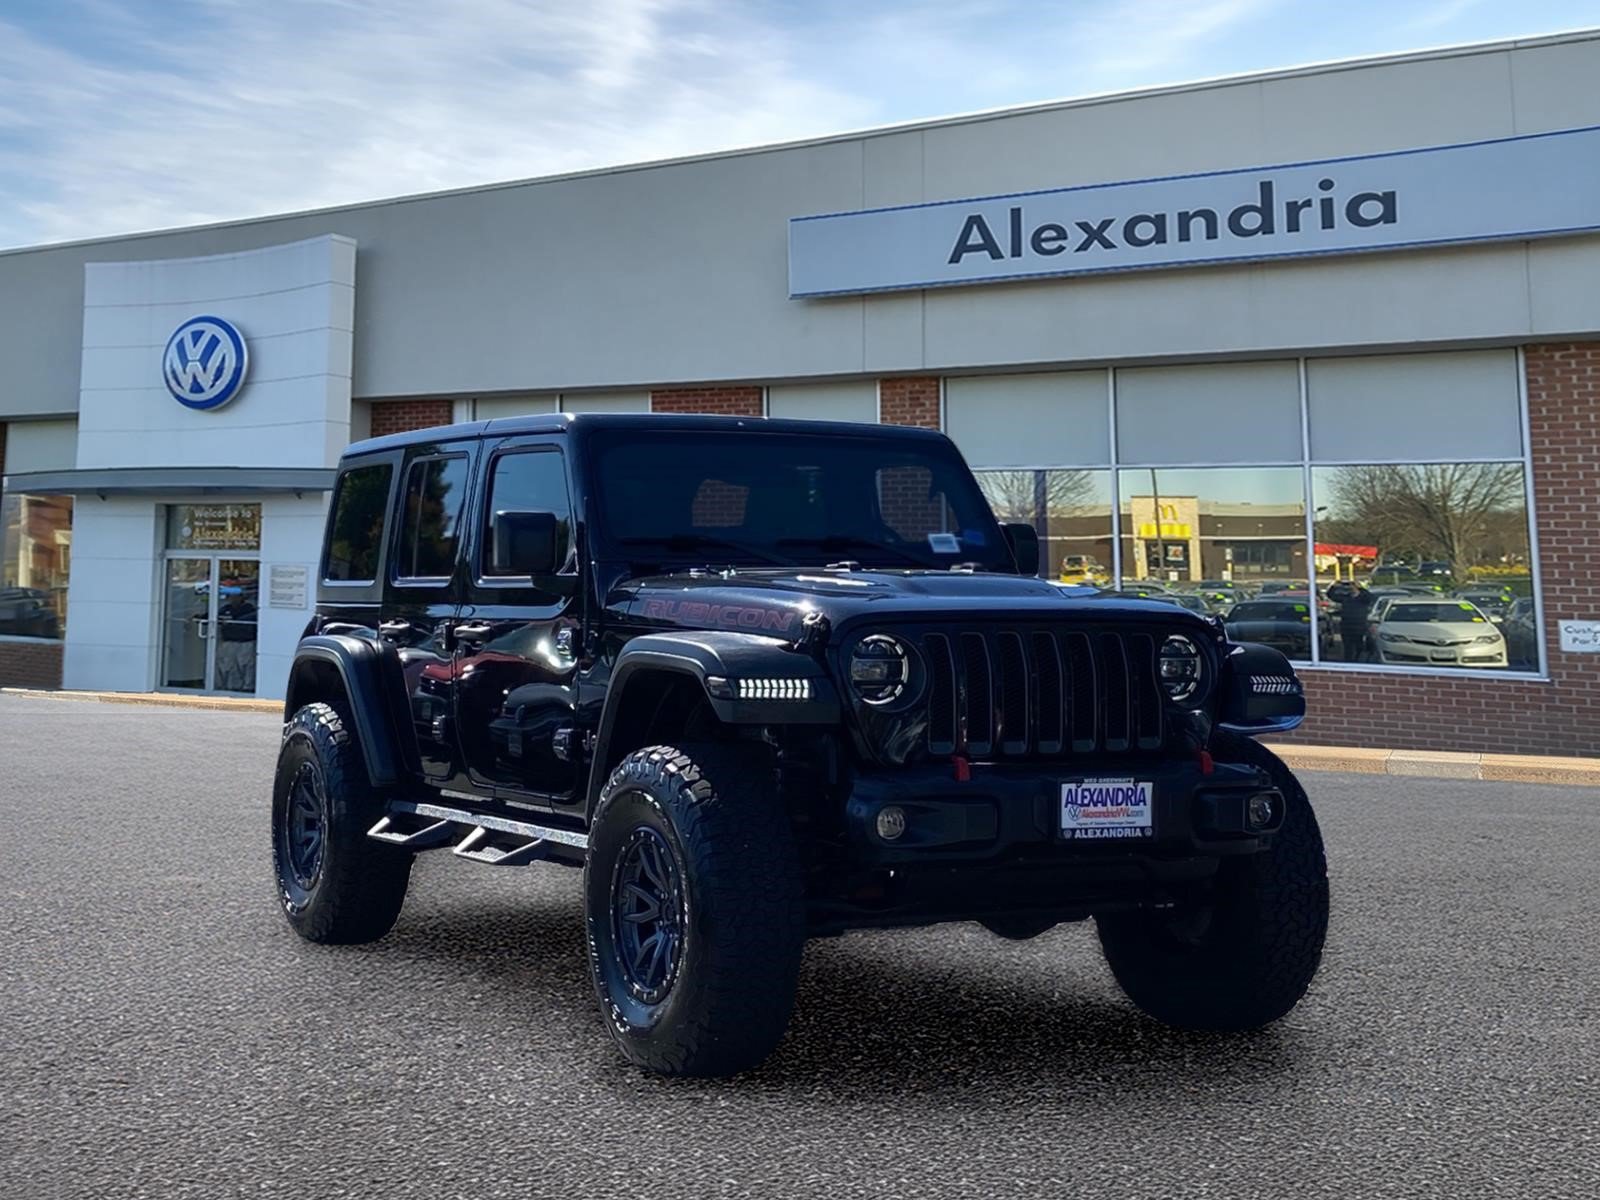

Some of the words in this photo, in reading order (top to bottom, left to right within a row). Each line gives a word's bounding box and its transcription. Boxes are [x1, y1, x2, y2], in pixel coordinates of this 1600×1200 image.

[948, 178, 1398, 264] Alexandria
[166, 320, 241, 403] VW
[194, 509, 239, 518] Welcome
[241, 509, 252, 518] to
[643, 599, 793, 632] RUBICON
[1064, 786, 1147, 808] ALEXANDRIA
[1074, 828, 1142, 839] ALEXANDRIA
